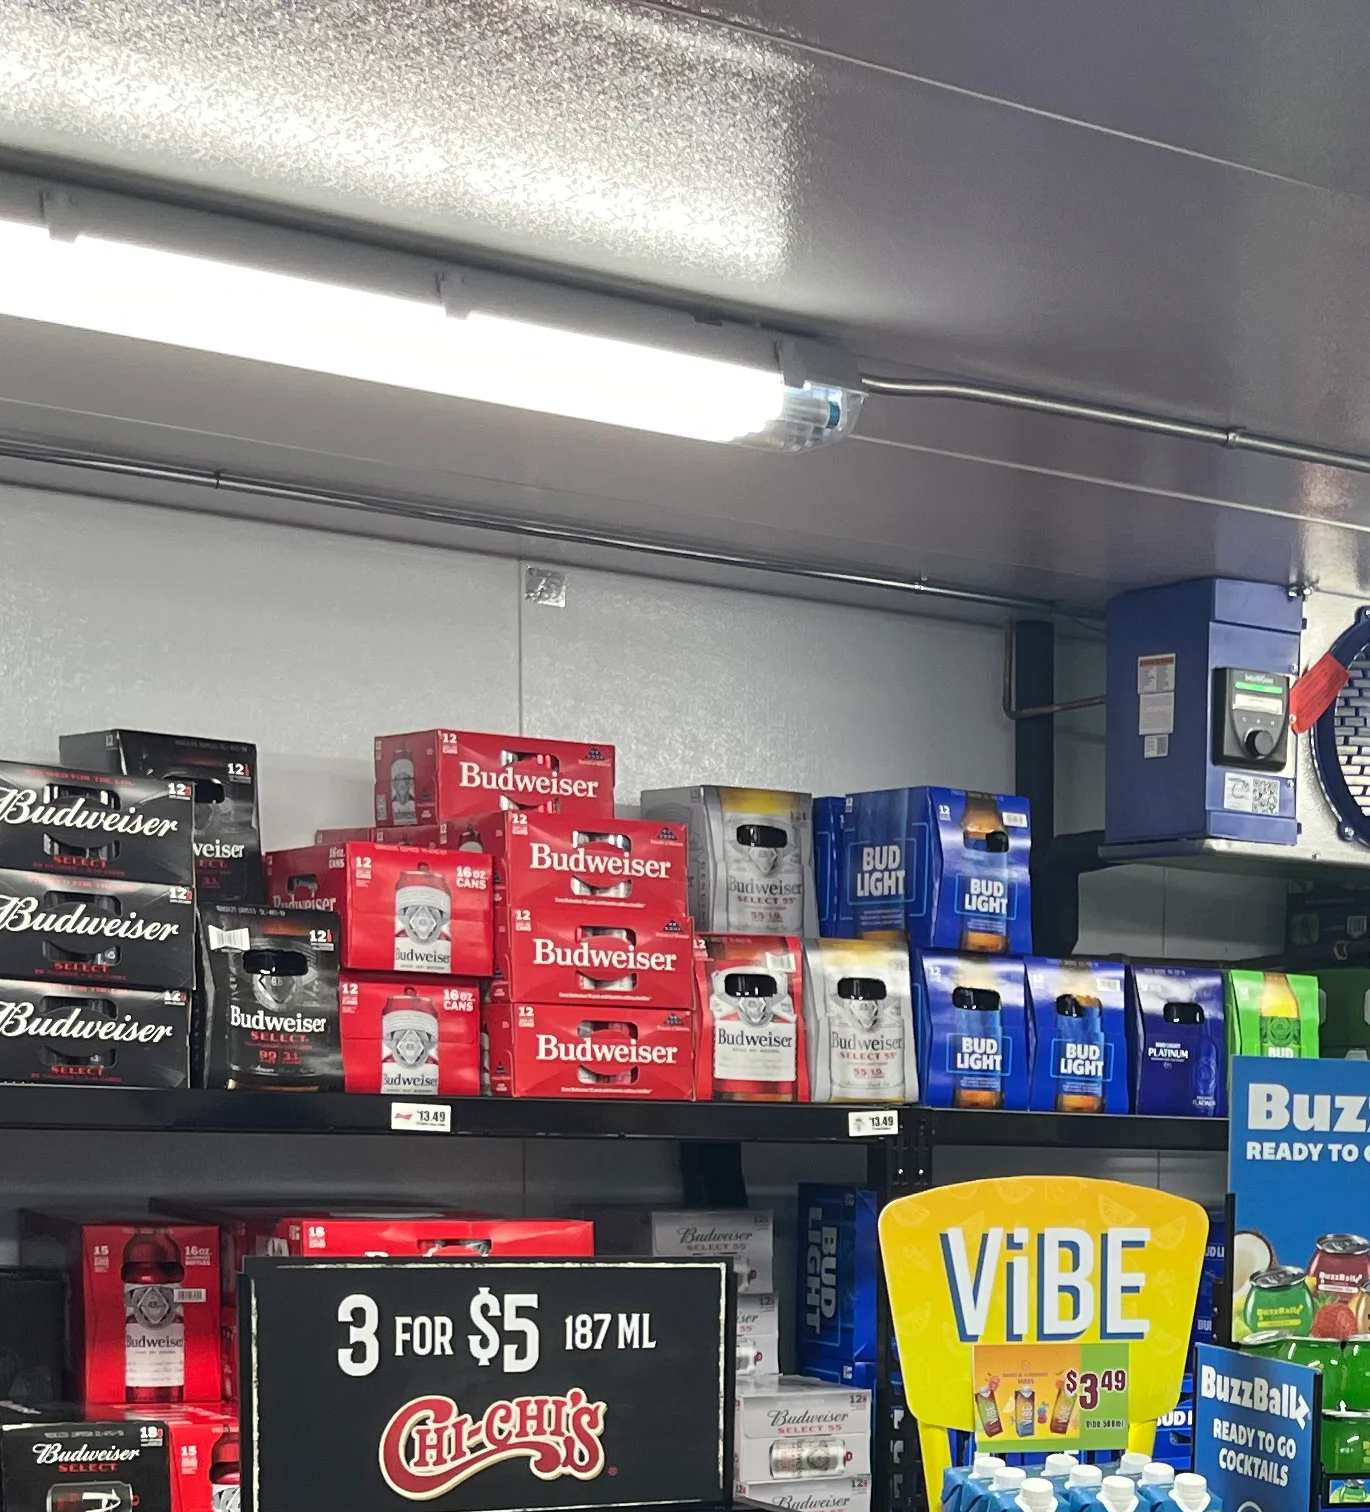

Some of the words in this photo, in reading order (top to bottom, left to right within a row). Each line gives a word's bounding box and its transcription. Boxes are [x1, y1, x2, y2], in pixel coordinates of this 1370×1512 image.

[442, 733, 456, 744] 12
[168, 782, 186, 795] 12
[460, 761, 598, 798] Budweiser
[0, 787, 178, 838] Budweiser
[512, 814, 528, 824] 12
[356, 857, 371, 868] 12
[530, 842, 671, 879] Budweiser
[862, 845, 900, 870] BUD
[456, 878, 486, 890] CANS
[729, 876, 802, 896] Budweiser
[857, 870, 905, 897] LIGHT
[970, 878, 1004, 896] BUD
[964, 895, 1008, 914] LIGHT
[0, 896, 179, 941] Budweiser
[515, 910, 531, 920] 12
[309, 930, 327, 943] 12
[533, 938, 677, 972] Budweiser
[0, 1000, 173, 1043] Budweiser
[230, 1005, 327, 1034] Budweiser
[718, 1029, 793, 1048] Budweiser
[831, 1032, 903, 1052] Budweiser
[962, 1037, 997, 1054] BUD
[536, 1034, 678, 1064] Budweiser
[1065, 1043, 1101, 1061] BUD
[1148, 1048, 1188, 1058] PLATINUM
[956, 1052, 1002, 1071] LIGHT
[1060, 1058, 1104, 1077] LIGHT
[1246, 1141, 1323, 1162] READY
[1328, 1143, 1359, 1163] TO
[677, 1226, 753, 1244] Budweiser
[93, 1245, 109, 1256] 15
[805, 1206, 822, 1334] LIGHT
[820, 1226, 837, 1319] BUD
[337, 1293, 380, 1377] 3
[394, 1315, 454, 1357] FOR
[468, 1286, 540, 1374] $5
[564, 1313, 609, 1351] 187
[616, 1313, 657, 1350] ML
[1201, 1365, 1311, 1430] BuzzBallz
[767, 1409, 849, 1426] Budweiser
[141, 1427, 157, 1438] 18
[777, 1425, 824, 1435] SELECT
[1213, 1418, 1255, 1448] READY
[1257, 1429, 1274, 1451] TO
[1277, 1437, 1296, 1460] GO
[32, 1442, 140, 1464] Budweiser
[58, 1463, 117, 1473] SELECT
[1219, 1448, 1289, 1487] COCKTAILS
